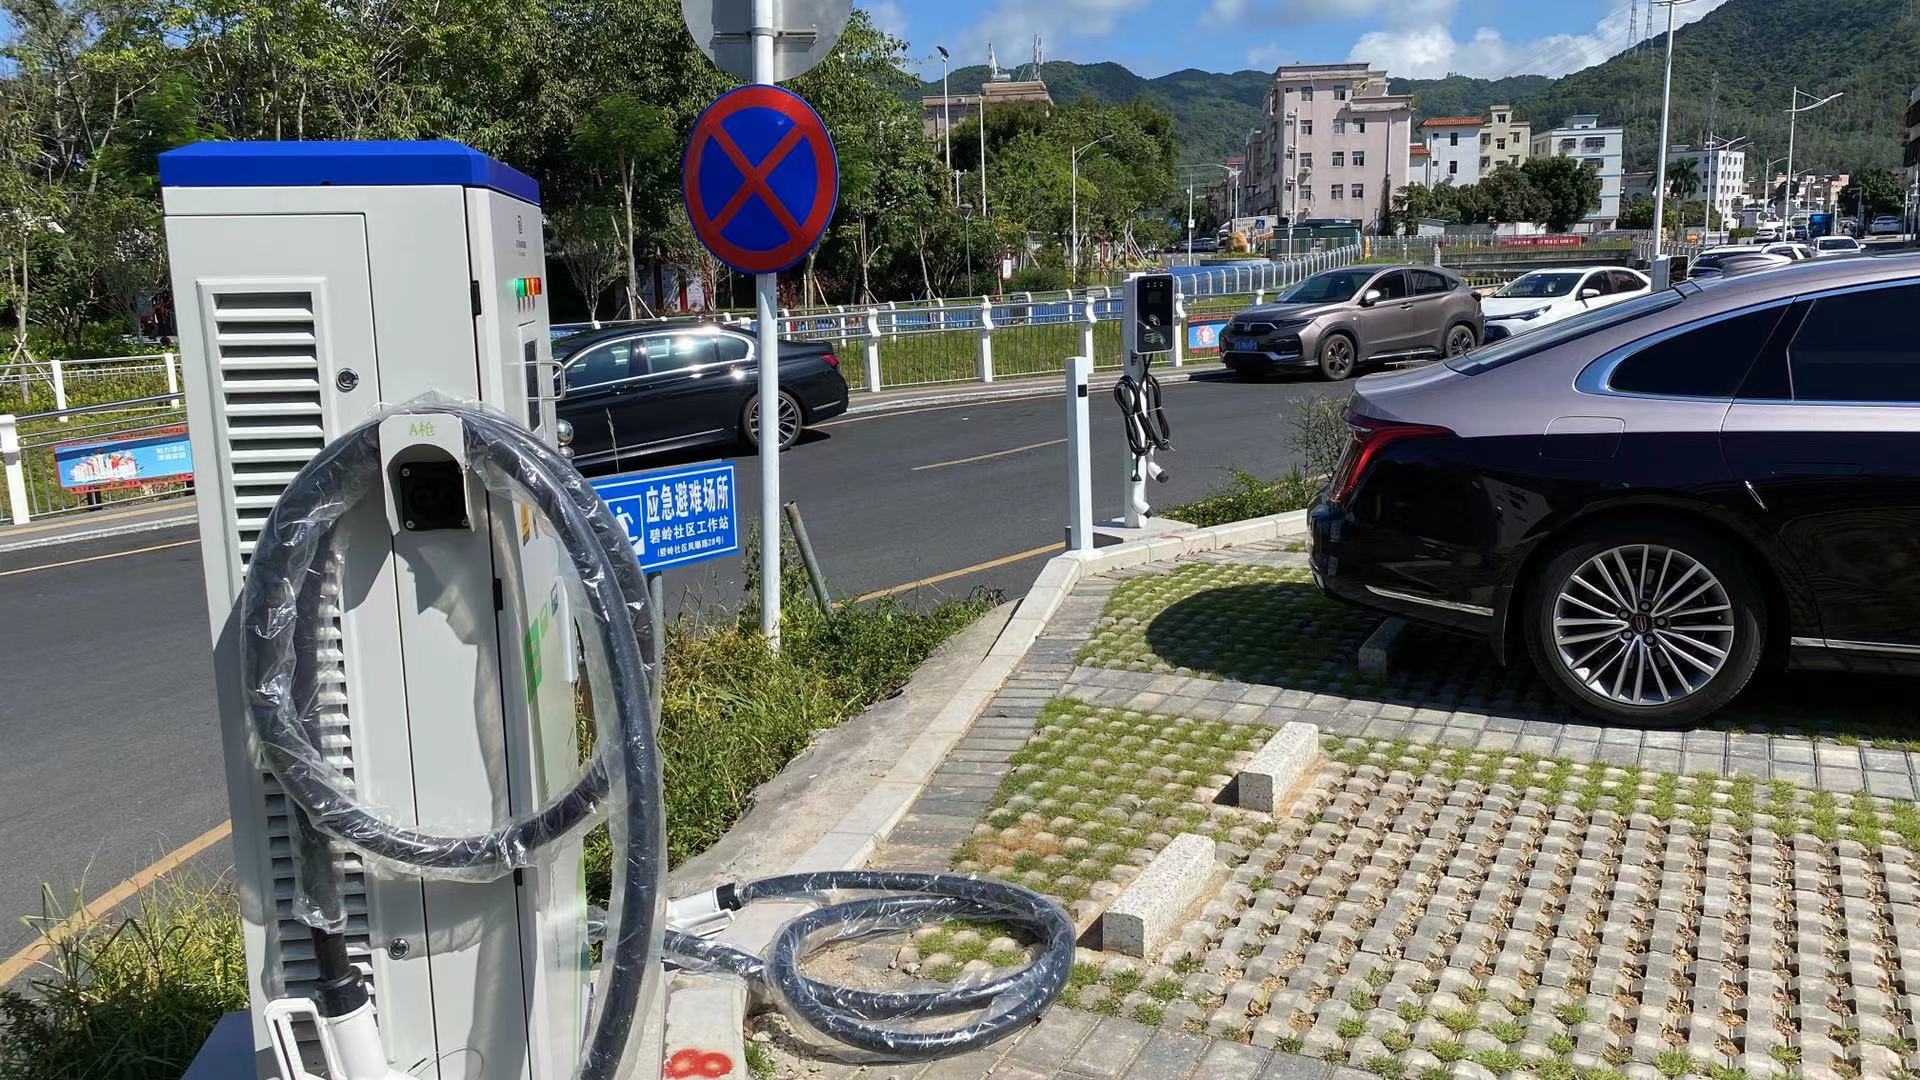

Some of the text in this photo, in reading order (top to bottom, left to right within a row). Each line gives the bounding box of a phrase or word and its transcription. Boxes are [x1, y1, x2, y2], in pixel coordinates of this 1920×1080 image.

[409, 421, 435, 437] A枪
[646, 474, 729, 524] 应急避难场所
[649, 515, 729, 545] 碧岭社区工作站
